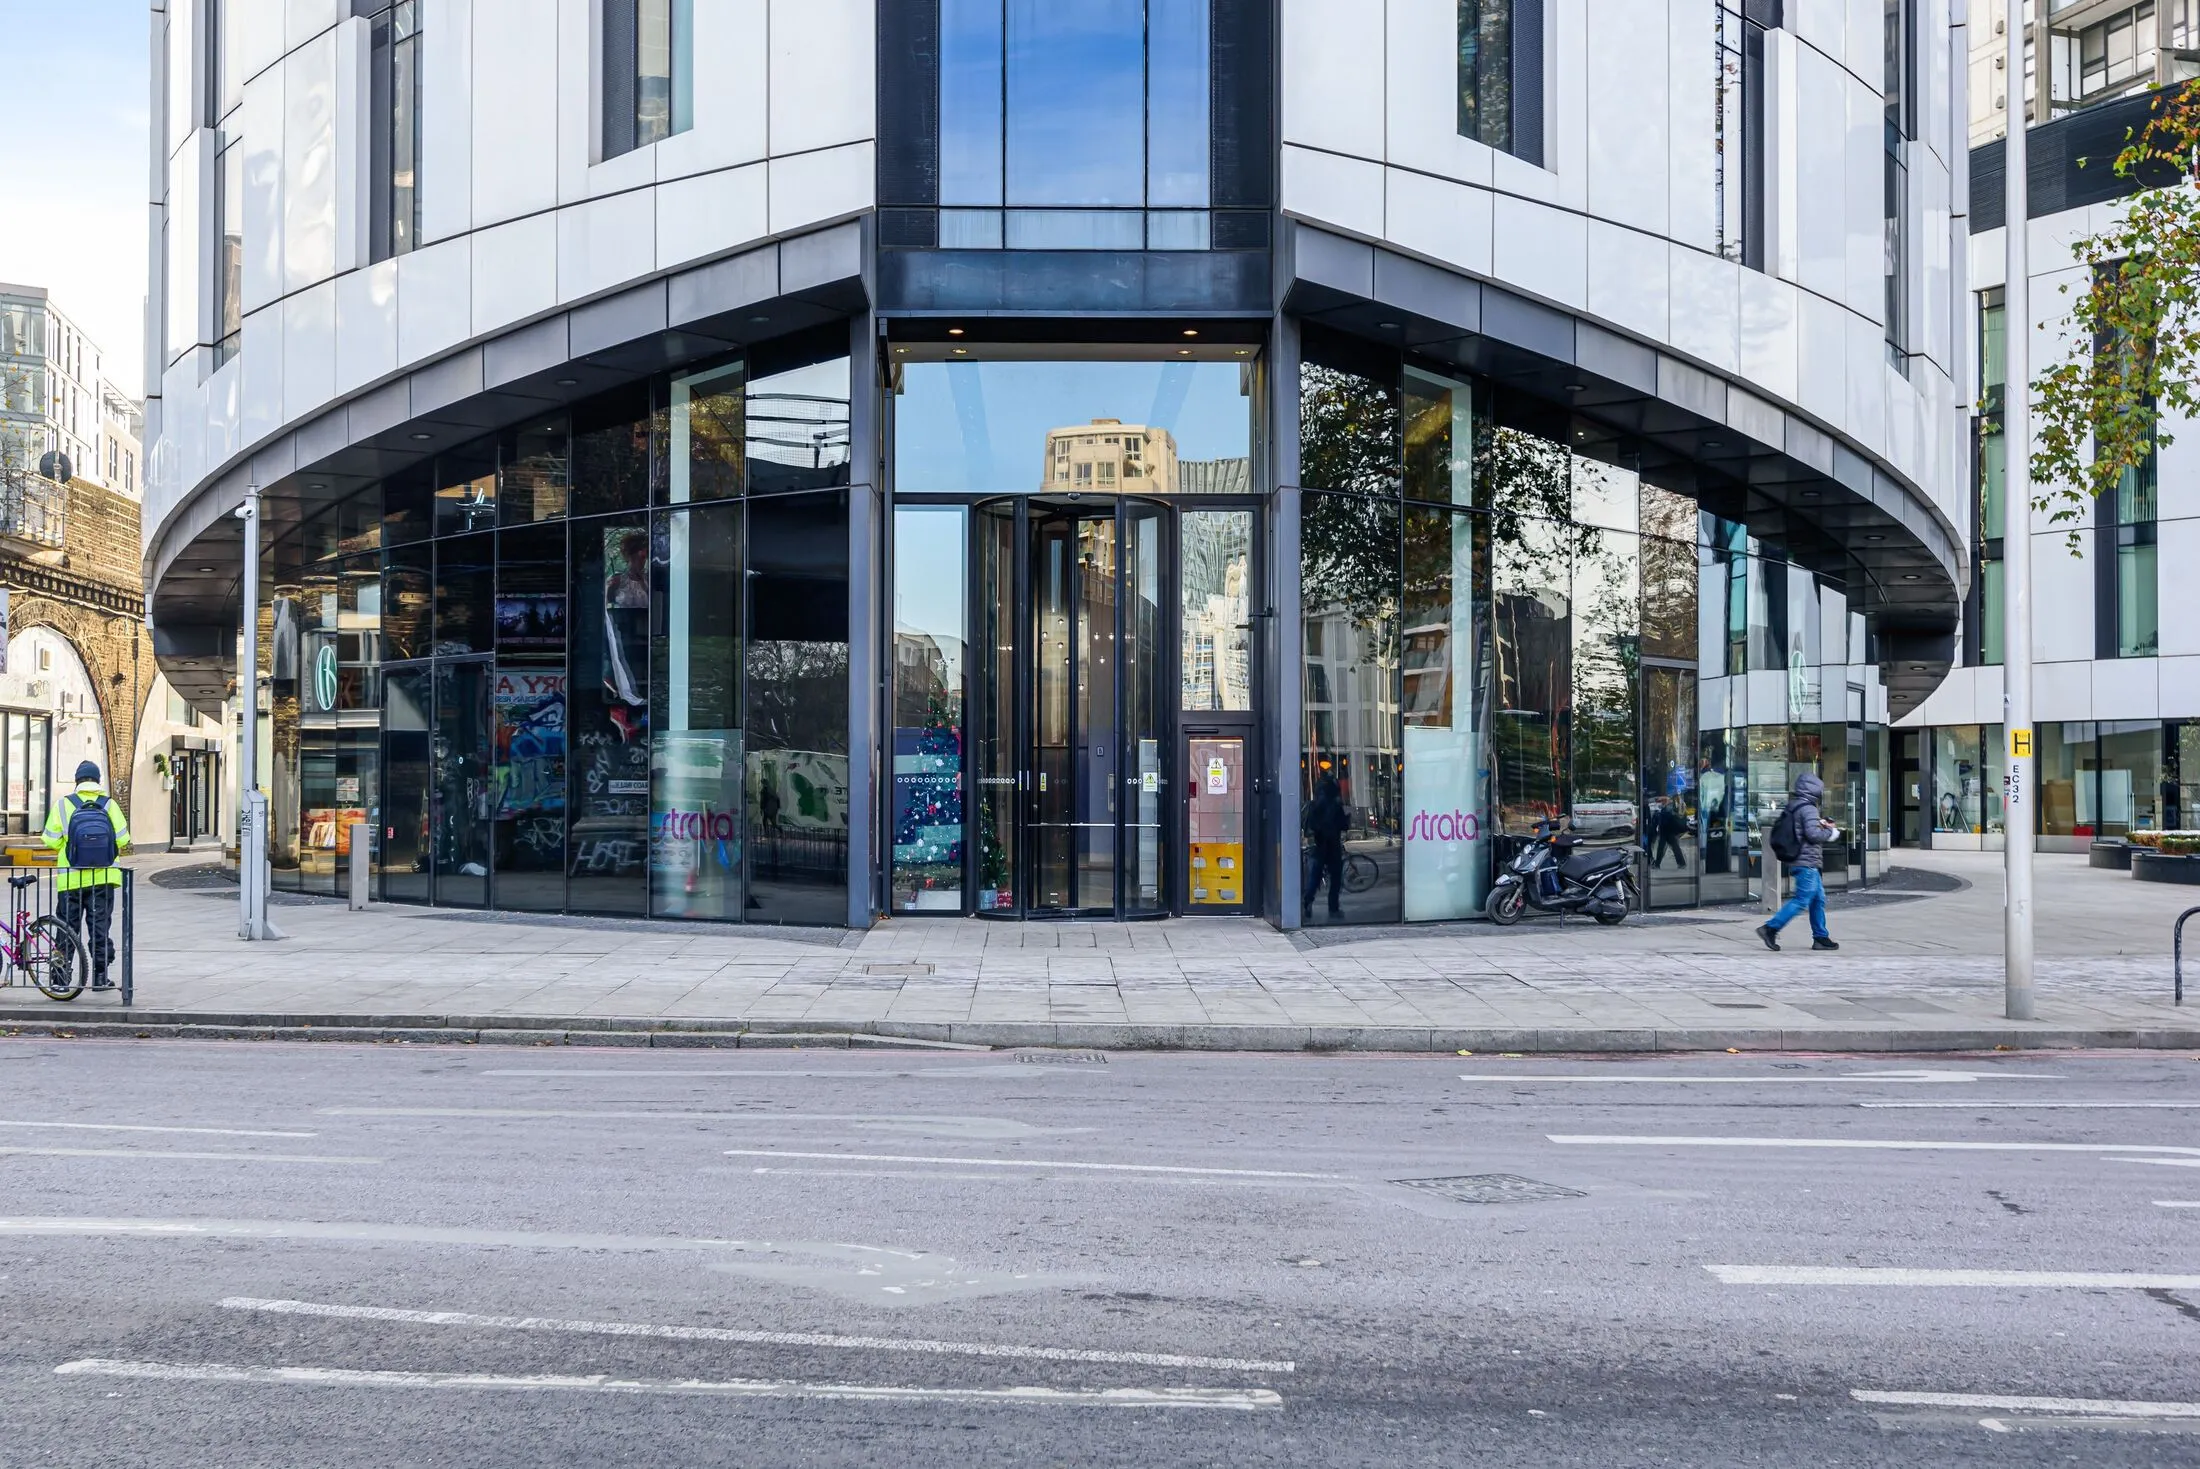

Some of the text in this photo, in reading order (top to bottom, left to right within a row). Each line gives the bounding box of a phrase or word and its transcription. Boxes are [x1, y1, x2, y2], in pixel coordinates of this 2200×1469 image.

[2014, 733, 2031, 754] H
[657, 808, 734, 841] strata
[1407, 809, 1479, 841] strata
